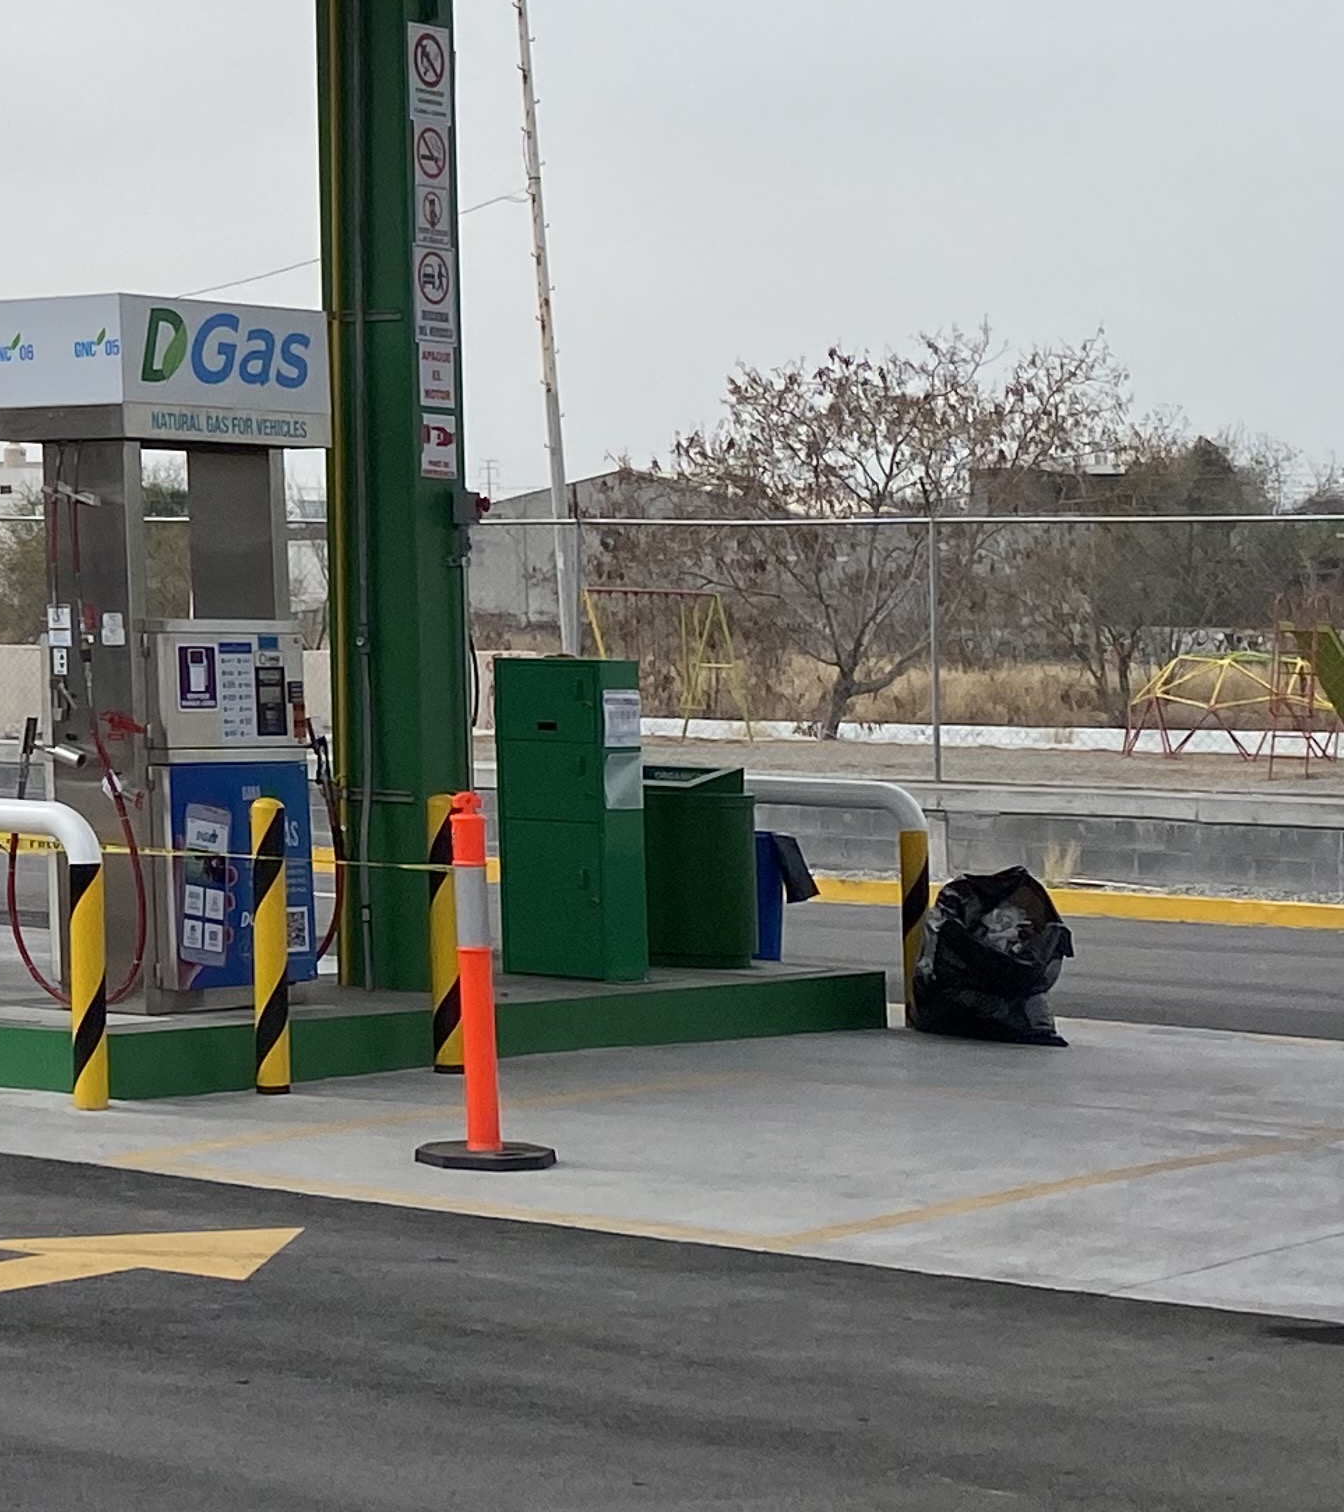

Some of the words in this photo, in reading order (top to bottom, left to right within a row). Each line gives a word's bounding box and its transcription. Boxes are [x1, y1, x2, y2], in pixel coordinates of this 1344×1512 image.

[74, 340, 98, 358] GNC
[104, 339, 120, 356] 05
[140, 307, 311, 389] DGas
[151, 411, 203, 432] NATURAL
[206, 414, 229, 434] GAS
[231, 417, 253, 436] FOR
[255, 419, 307, 439] VEHICLES
